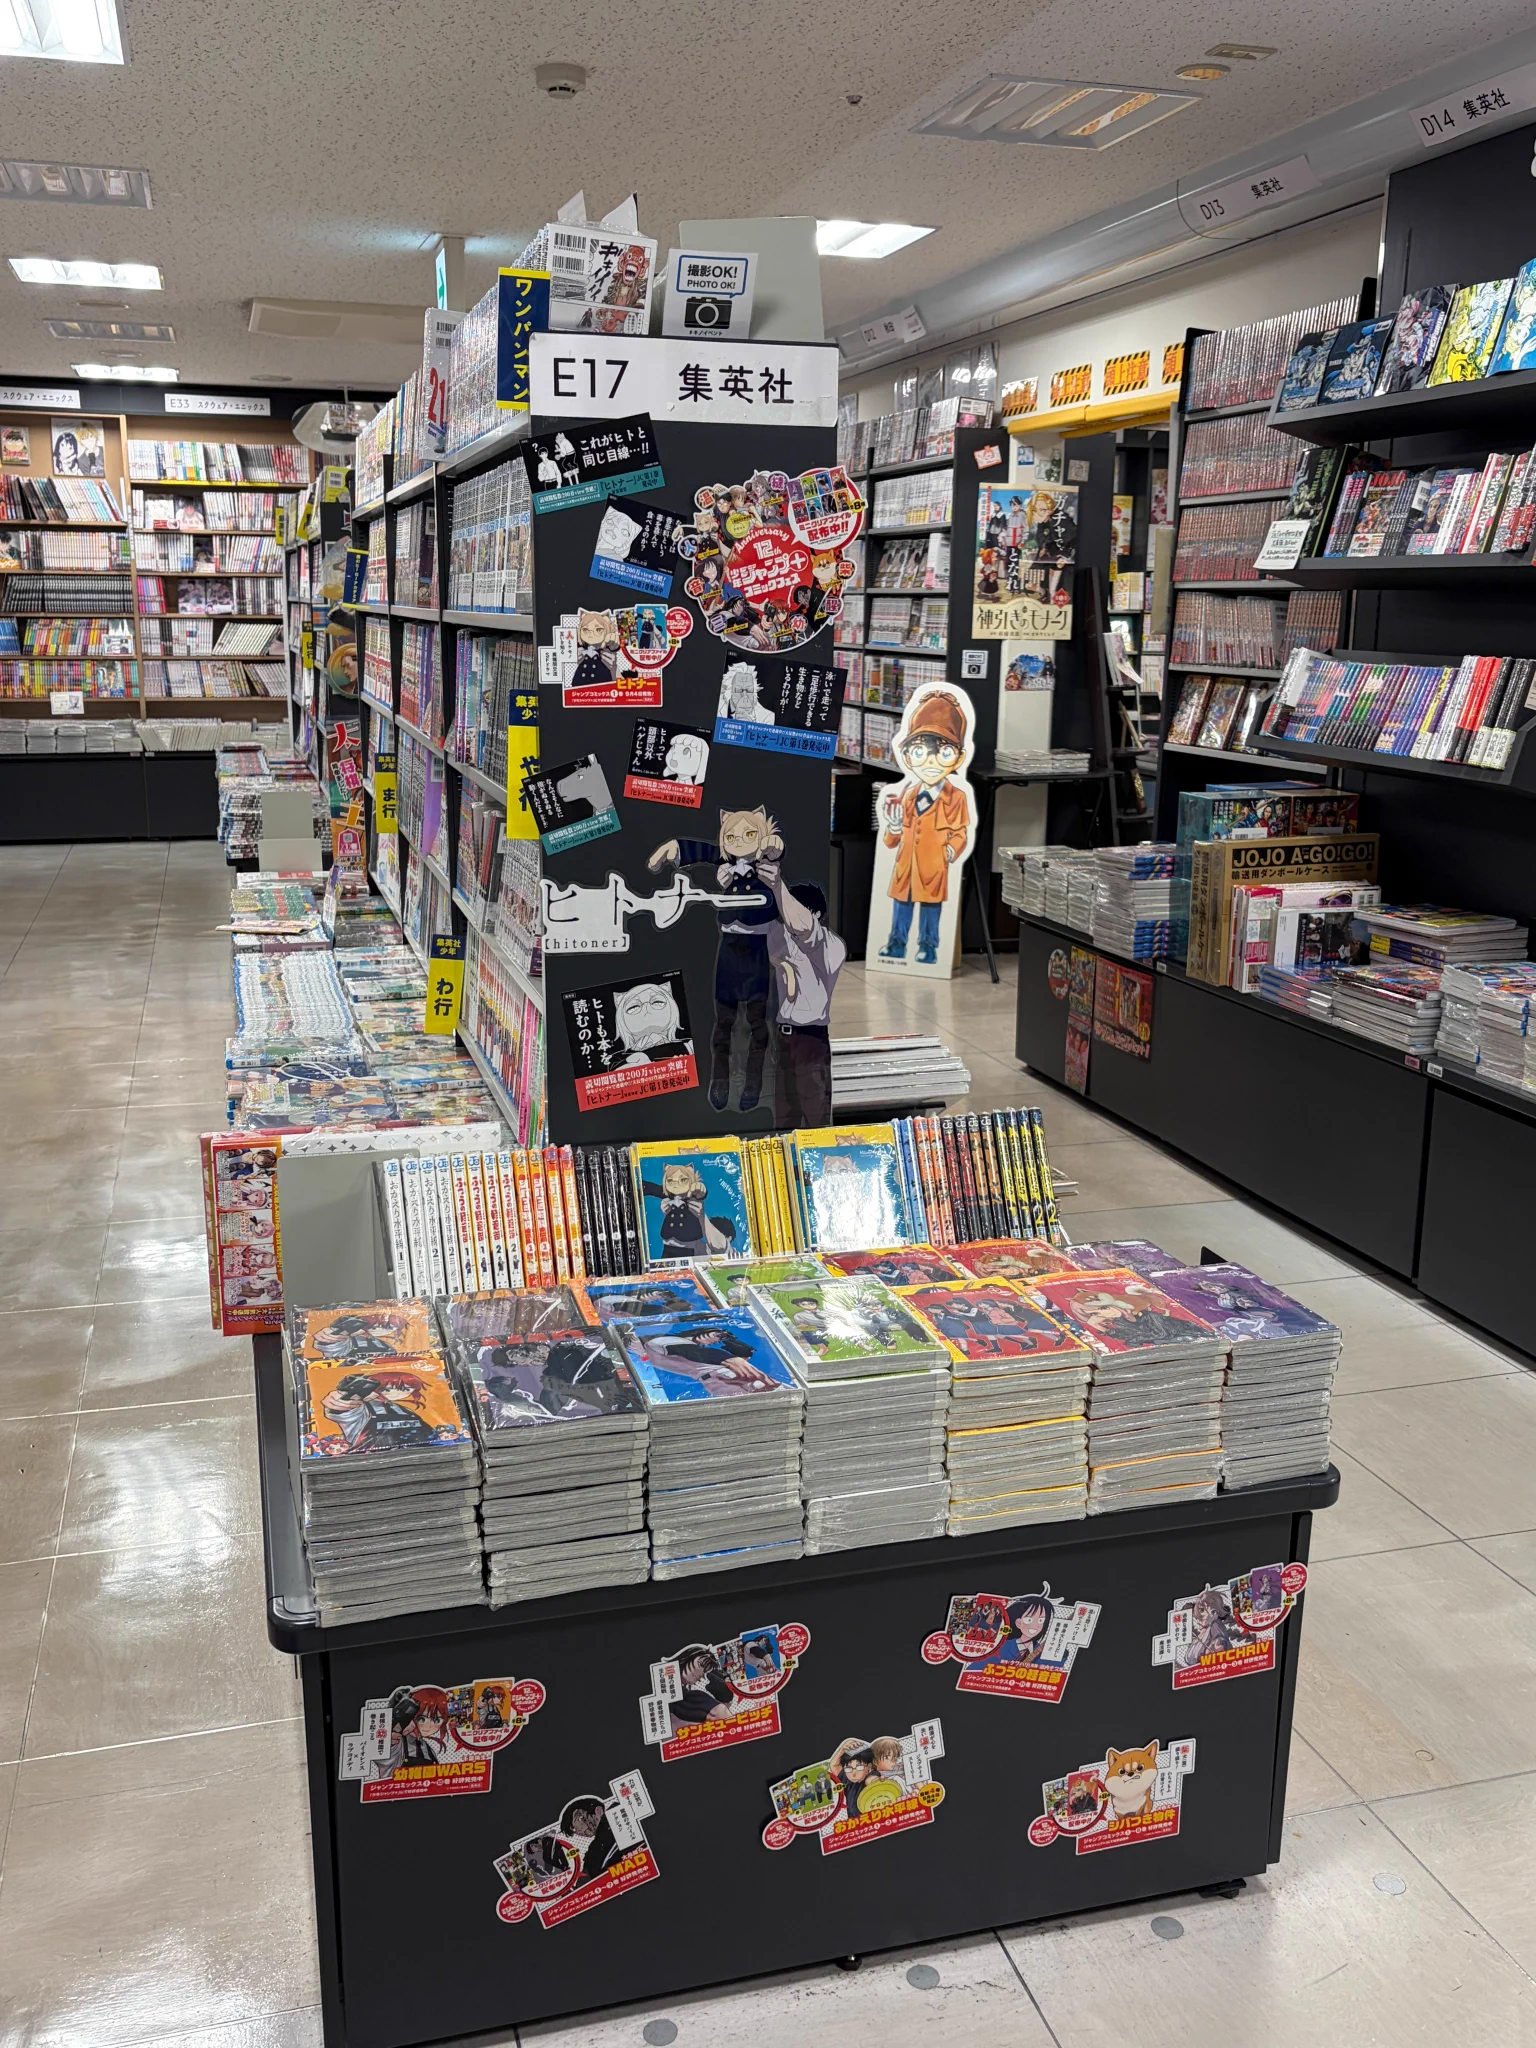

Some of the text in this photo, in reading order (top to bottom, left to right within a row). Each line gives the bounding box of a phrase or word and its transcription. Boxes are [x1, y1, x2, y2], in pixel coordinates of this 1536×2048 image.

[1420, 88, 1511, 137] D14 集英社
[1199, 177, 1284, 220] D13 集英社
[687, 264, 738, 278] 撮影OK!
[687, 280, 735, 289] PHOTO OK!
[513, 278, 530, 400] ワンパンマン
[554, 358, 795, 404] E17 集英社
[1105, 358, 1149, 387] 頭上注意
[3, 391, 74, 402] スクウェア・エニックス
[170, 399, 265, 411] E33 スクウェア・エニックス
[428, 367, 446, 431] 21
[580, 426, 646, 451] これがヒトと
[799, 512, 851, 530] ミニクリアファイル
[807, 521, 849, 541] 配布中!!
[735, 526, 790, 554] Anniversary
[744, 573, 801, 598] コミックフェス
[977, 605, 1068, 631] 神引きのモナーク
[616, 680, 657, 690] ヒトナー
[795, 667, 807, 709] 生き物など
[820, 671, 833, 721] 泳いで走って
[632, 725, 646, 766] ハゲじゃん
[644, 726, 657, 760] 頭部以外
[656, 728, 667, 761] ヒトって
[779, 736, 830, 753] JC第1巻発売中
[339, 758, 361, 790] 将棋
[382, 787, 396, 819] ま行
[1234, 848, 1285, 867] JOJO
[1232, 866, 1330, 880] 輸送用ダンボールケース
[545, 877, 765, 927] ヒトナー
[436, 938, 461, 948] 集英社
[439, 947, 456, 956] 少年
[433, 977, 454, 1016] わ行
[592, 998, 612, 1065] ヒトも本を
[639, 1078, 690, 1094] JC第1巻発売中
[389, 1181, 403, 1249] おかえり水平線
[424, 1178, 438, 1246] おかえり水平線
[398, 1252, 403, 1260] 1
[432, 1248, 439, 1258] 2
[448, 1247, 455, 1256] 2
[465, 1248, 470, 1256] 1
[496, 1245, 502, 1253] 2
[511, 1244, 517, 1252] 2
[1200, 1642, 1269, 1666] WITCHRIV
[982, 1663, 1061, 1685] ふつうの軽音部
[677, 1706, 773, 1739] サンキューピッチ
[394, 1762, 486, 1781] 幼稚園WARS
[834, 1799, 919, 1834] おかえり水平線
[1108, 1809, 1175, 1831] シバつき物件
[608, 1854, 648, 1878] MAD
